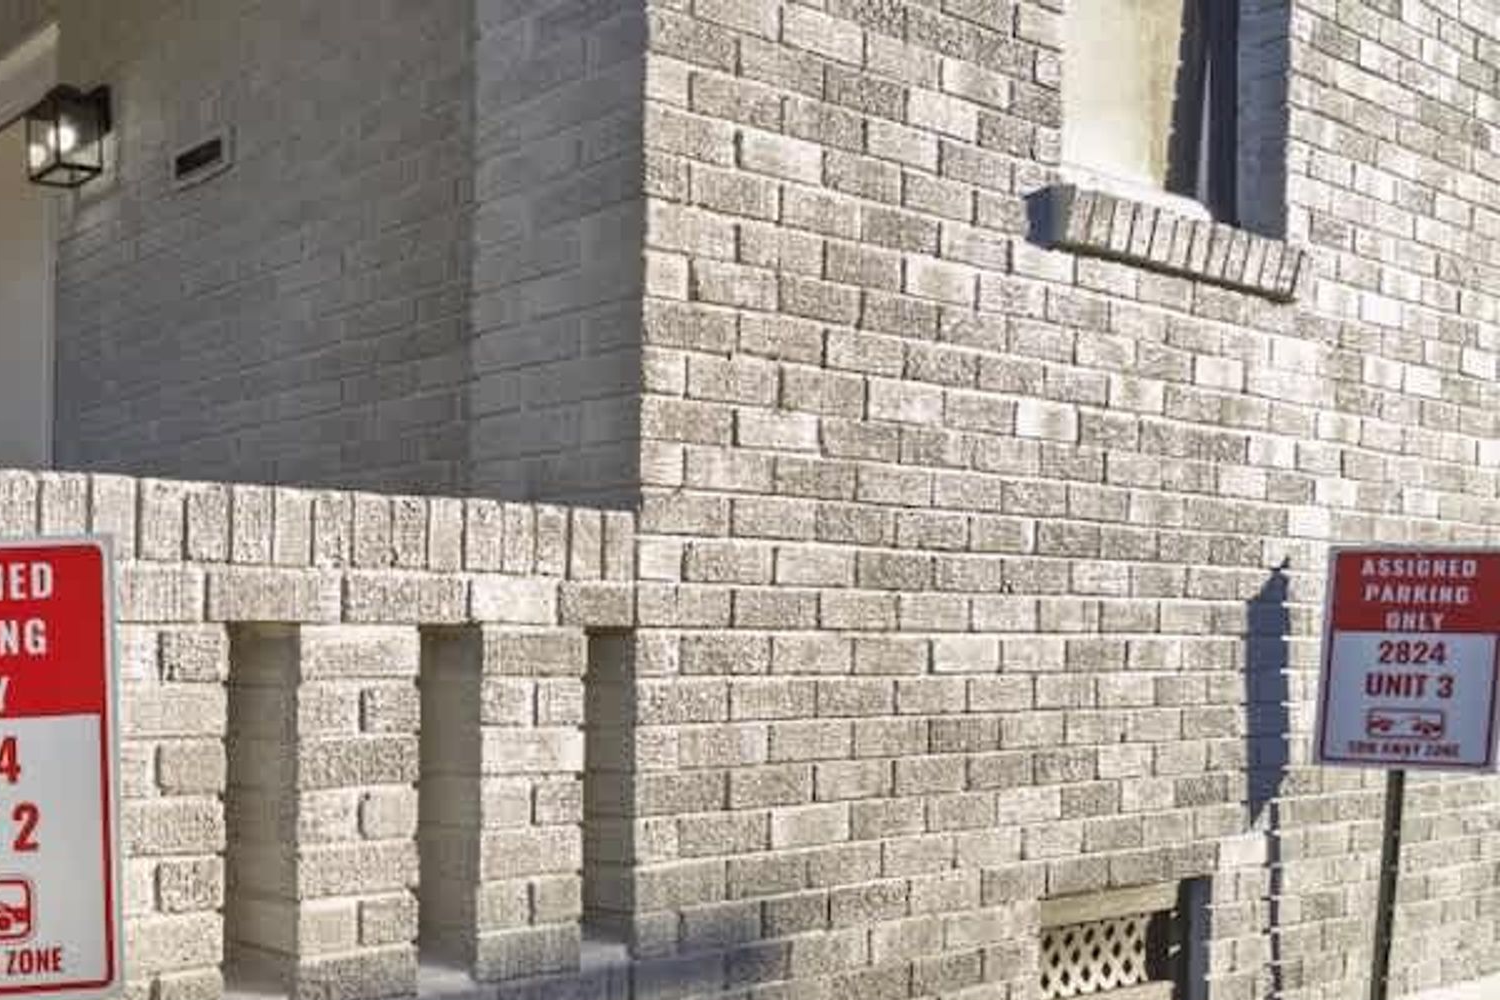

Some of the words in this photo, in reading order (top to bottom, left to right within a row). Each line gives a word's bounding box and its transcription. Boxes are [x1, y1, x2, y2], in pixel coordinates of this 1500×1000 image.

[1361, 559, 1477, 577] ASSIGNED
[1365, 585, 1470, 604] PARKING
[1385, 612, 1445, 631] ONLY
[1379, 640, 1446, 665] 2824
[1365, 672, 1428, 697] UNIT
[1436, 675, 1455, 698] 3
[13, 802, 40, 853] 2
[6, 947, 64, 975] ZONE
